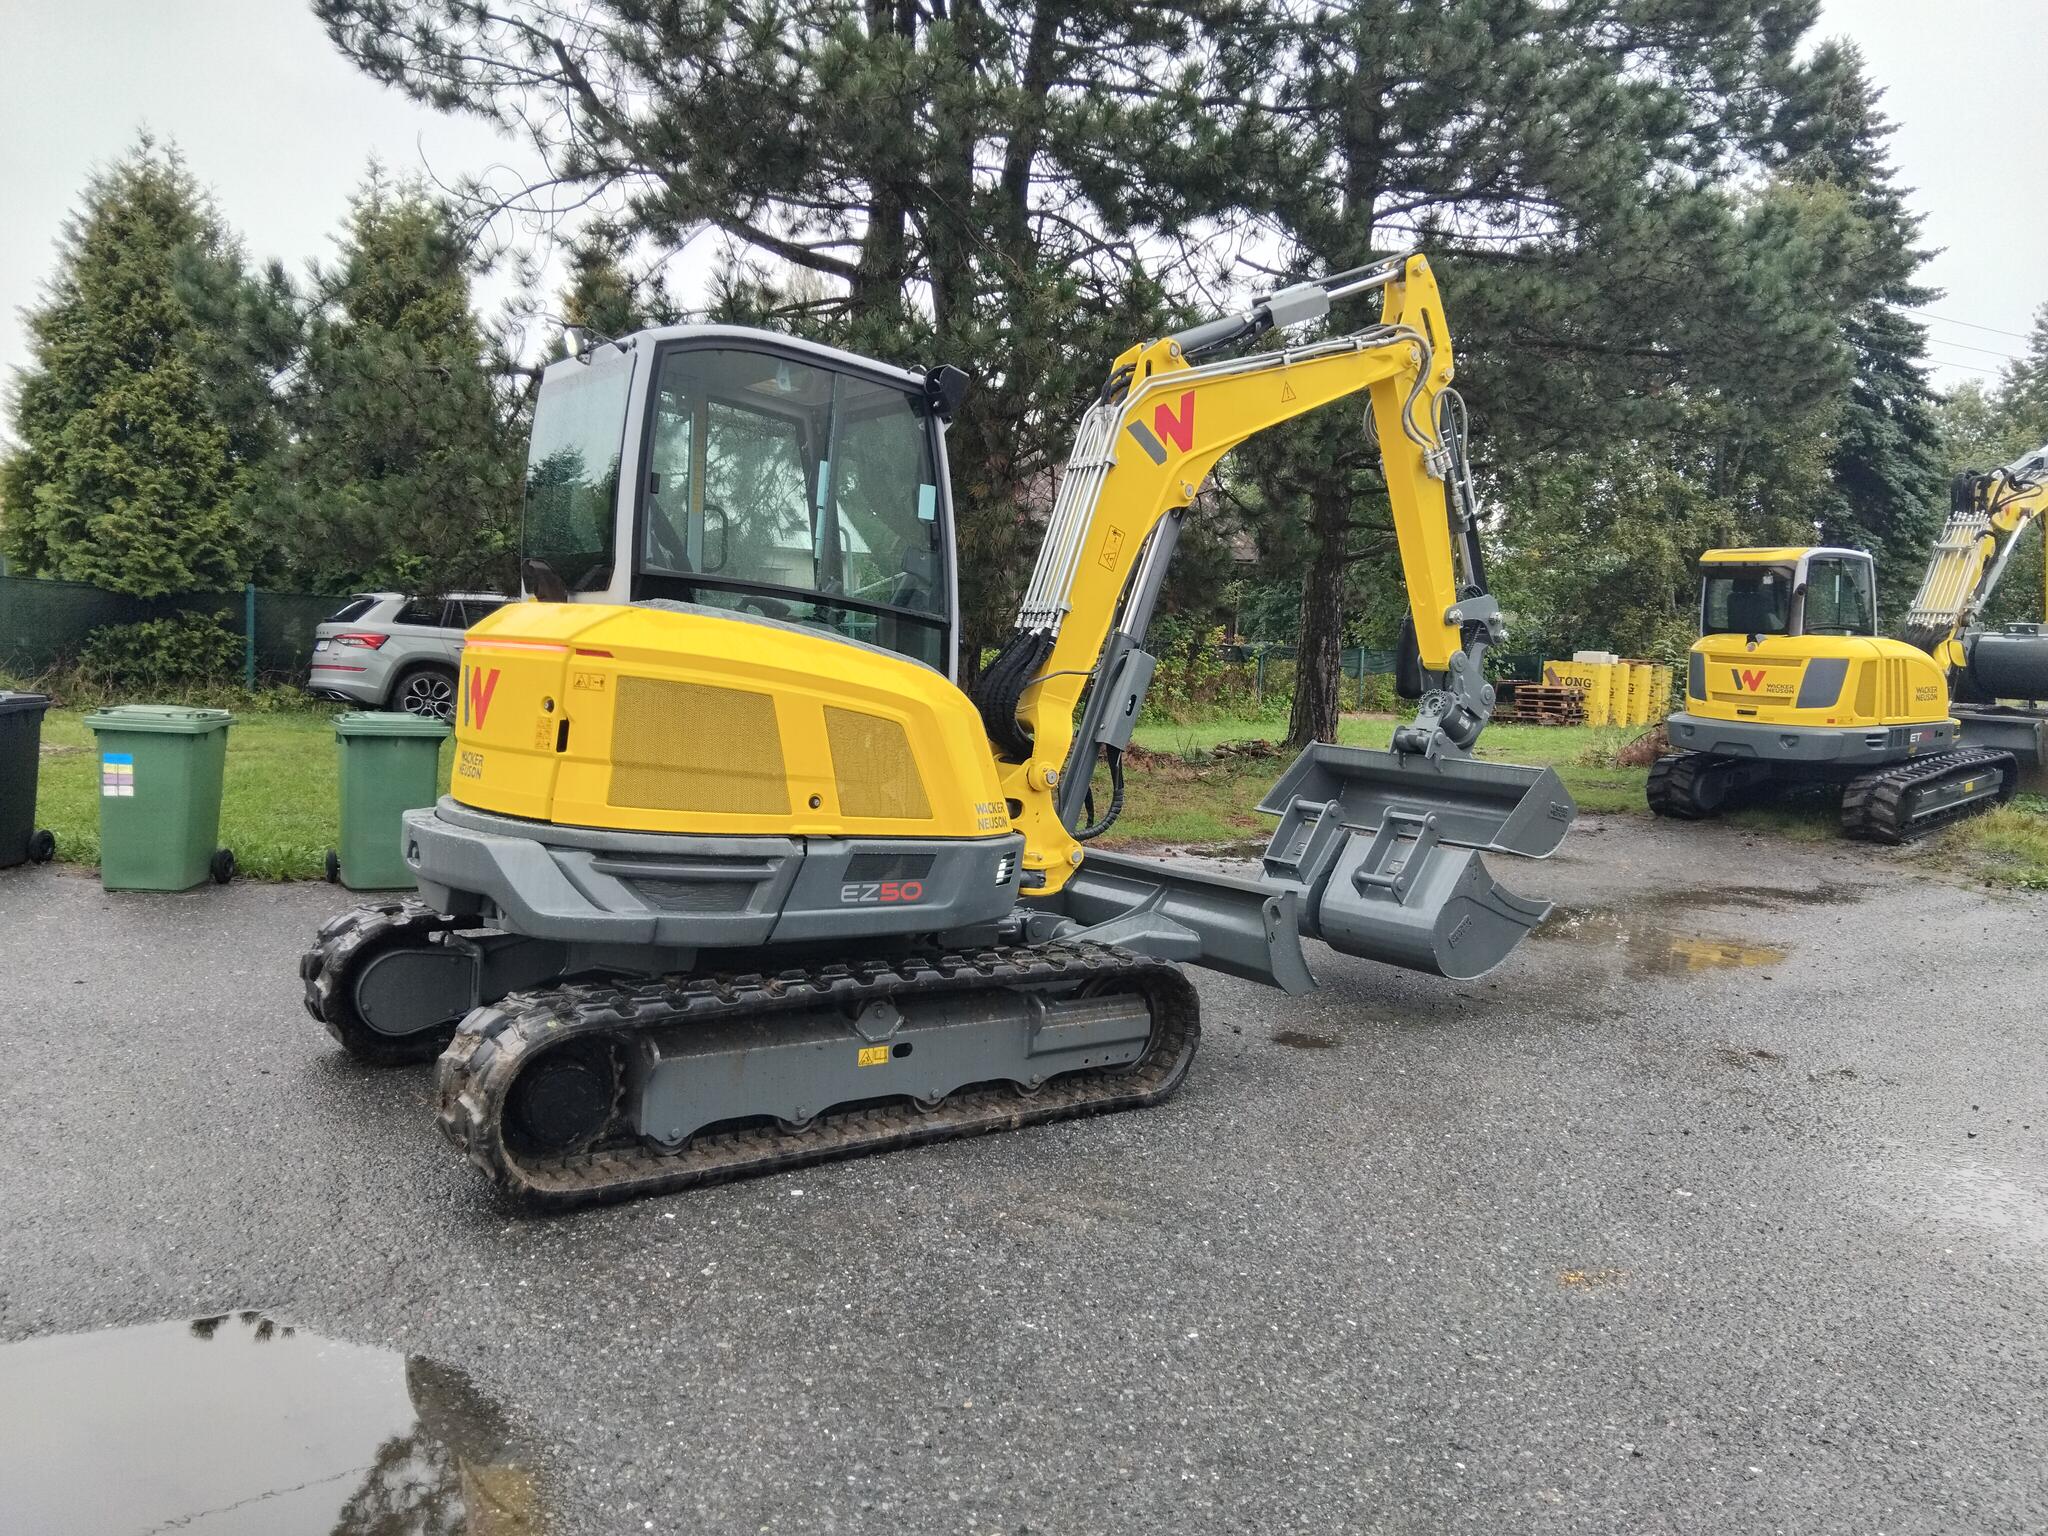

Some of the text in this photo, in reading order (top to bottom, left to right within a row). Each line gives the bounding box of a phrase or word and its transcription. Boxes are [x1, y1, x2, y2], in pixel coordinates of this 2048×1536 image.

[462, 751, 484, 767] WACKER
[459, 763, 481, 779] NEUSON
[975, 801, 1005, 815] WACKER
[978, 816, 1008, 831] NEUSON
[840, 882, 923, 903] EZ50
